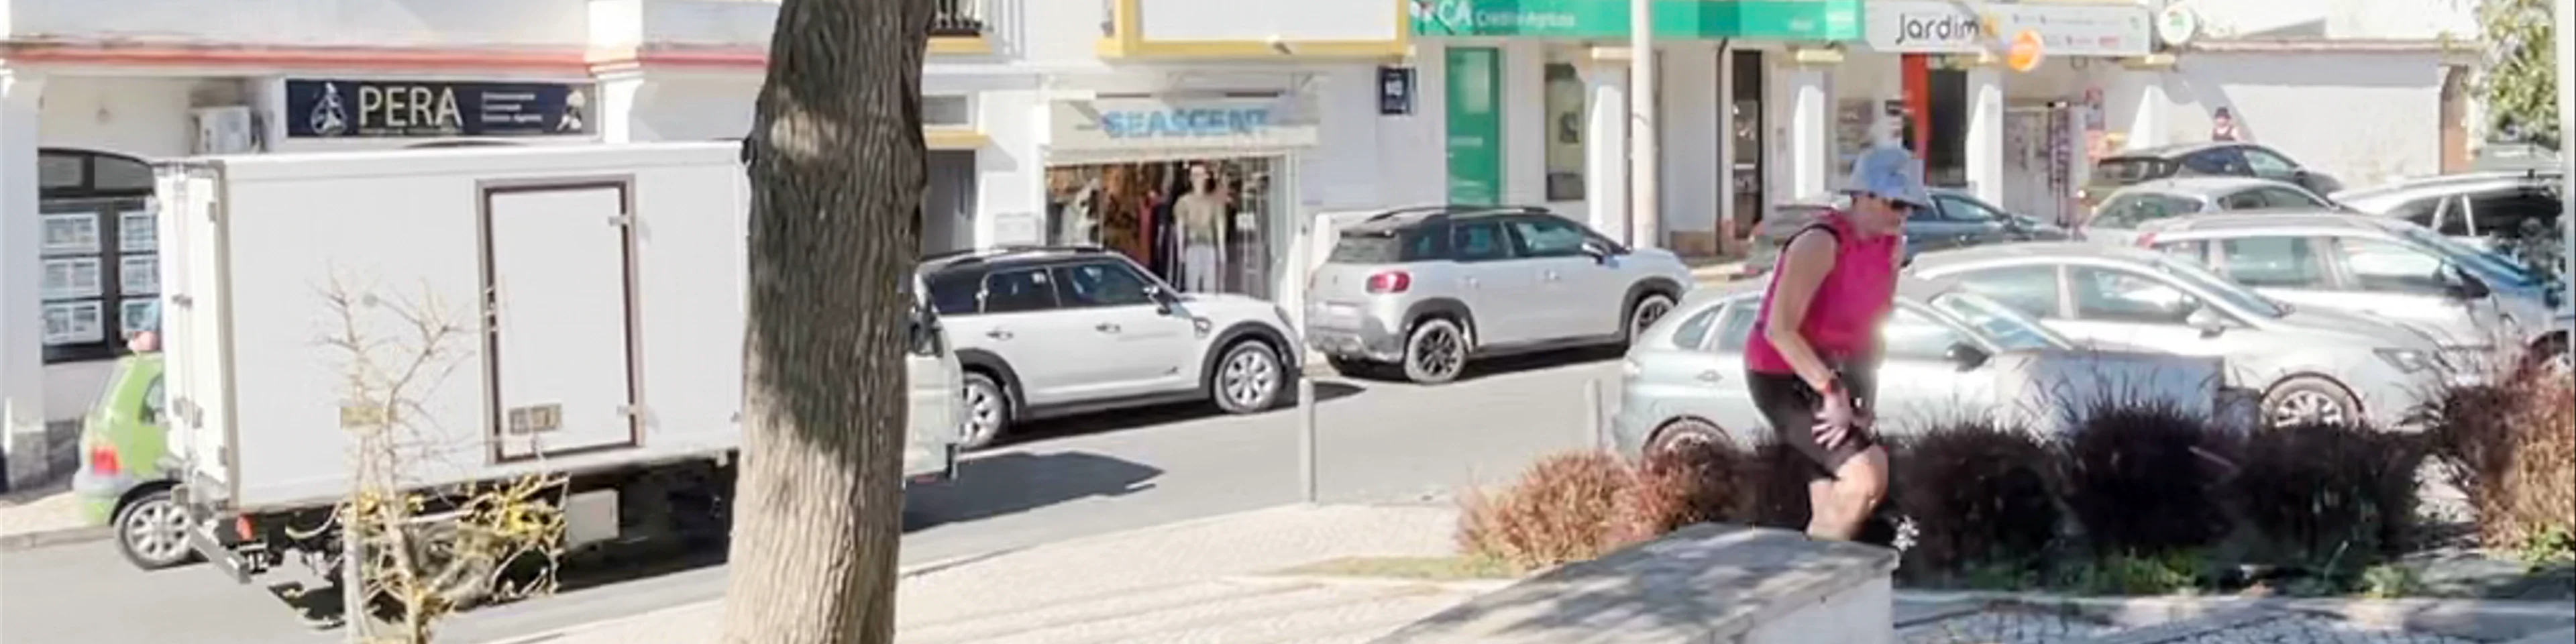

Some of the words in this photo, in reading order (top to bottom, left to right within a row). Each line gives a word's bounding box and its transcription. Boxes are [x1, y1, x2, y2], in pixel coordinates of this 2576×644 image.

[1895, 13, 1980, 45] Jardim
[358, 87, 464, 127] PERA
[1102, 109, 1267, 138] SEASCENT
